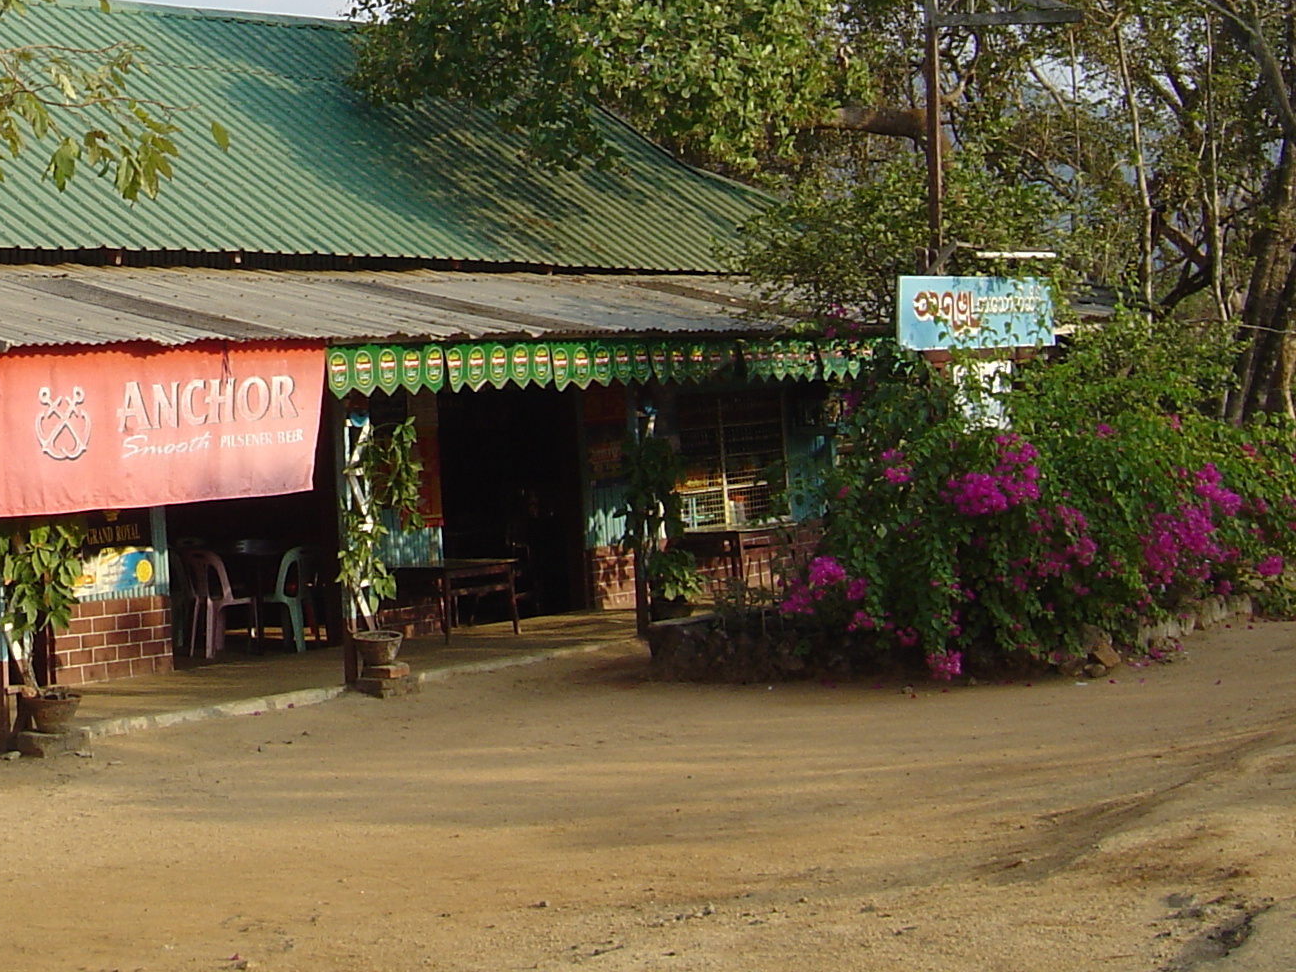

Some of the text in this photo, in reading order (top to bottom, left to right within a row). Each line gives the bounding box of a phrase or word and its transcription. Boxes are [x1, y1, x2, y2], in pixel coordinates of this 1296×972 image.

[116, 375, 299, 433] ANCHOR
[122, 429, 304, 458] Smooth PILSENER BEER
[86, 523, 141, 545] GRAND ROYAL
